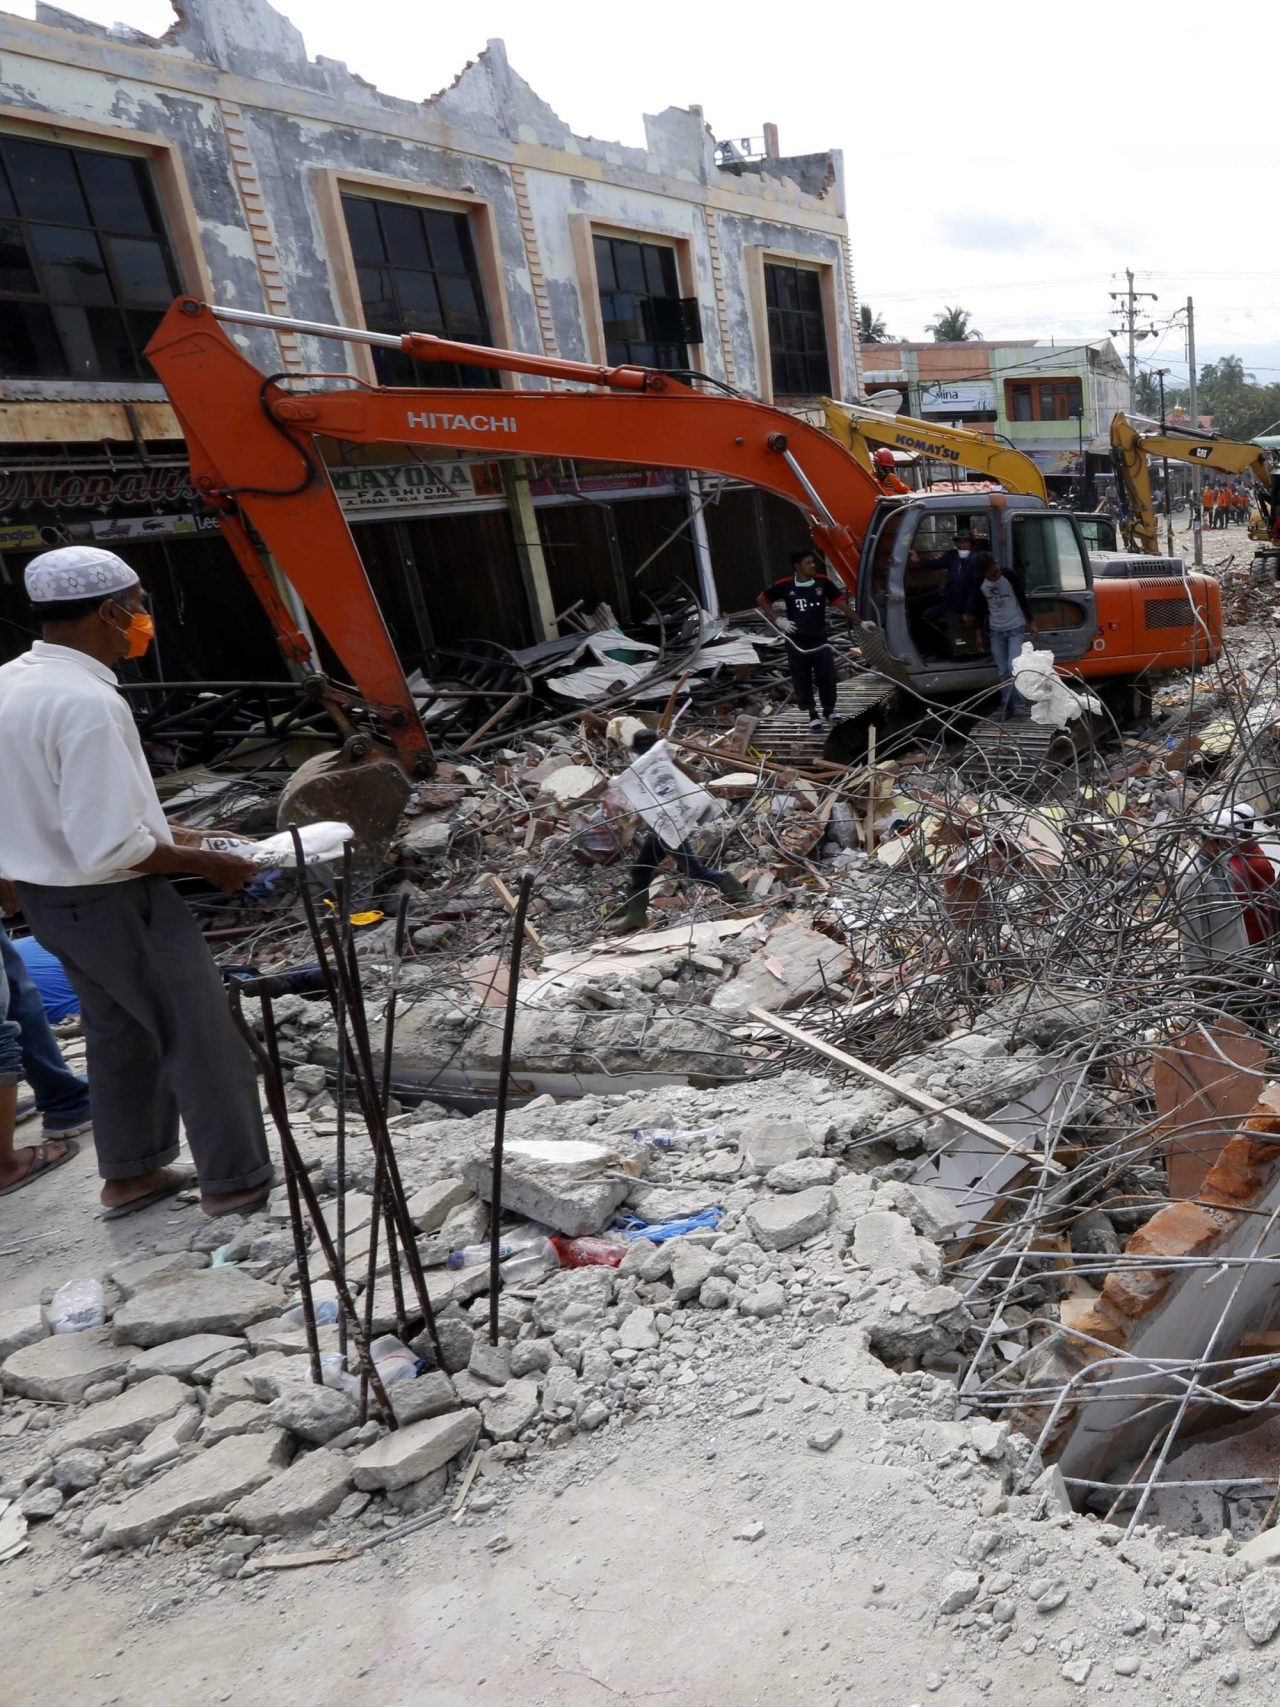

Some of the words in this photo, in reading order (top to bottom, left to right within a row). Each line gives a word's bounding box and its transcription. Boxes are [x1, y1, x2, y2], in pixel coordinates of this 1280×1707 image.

[407, 411, 517, 432] HITACHI
[896, 434, 960, 460] KOMATSU
[358, 486, 446, 499] FASHION
